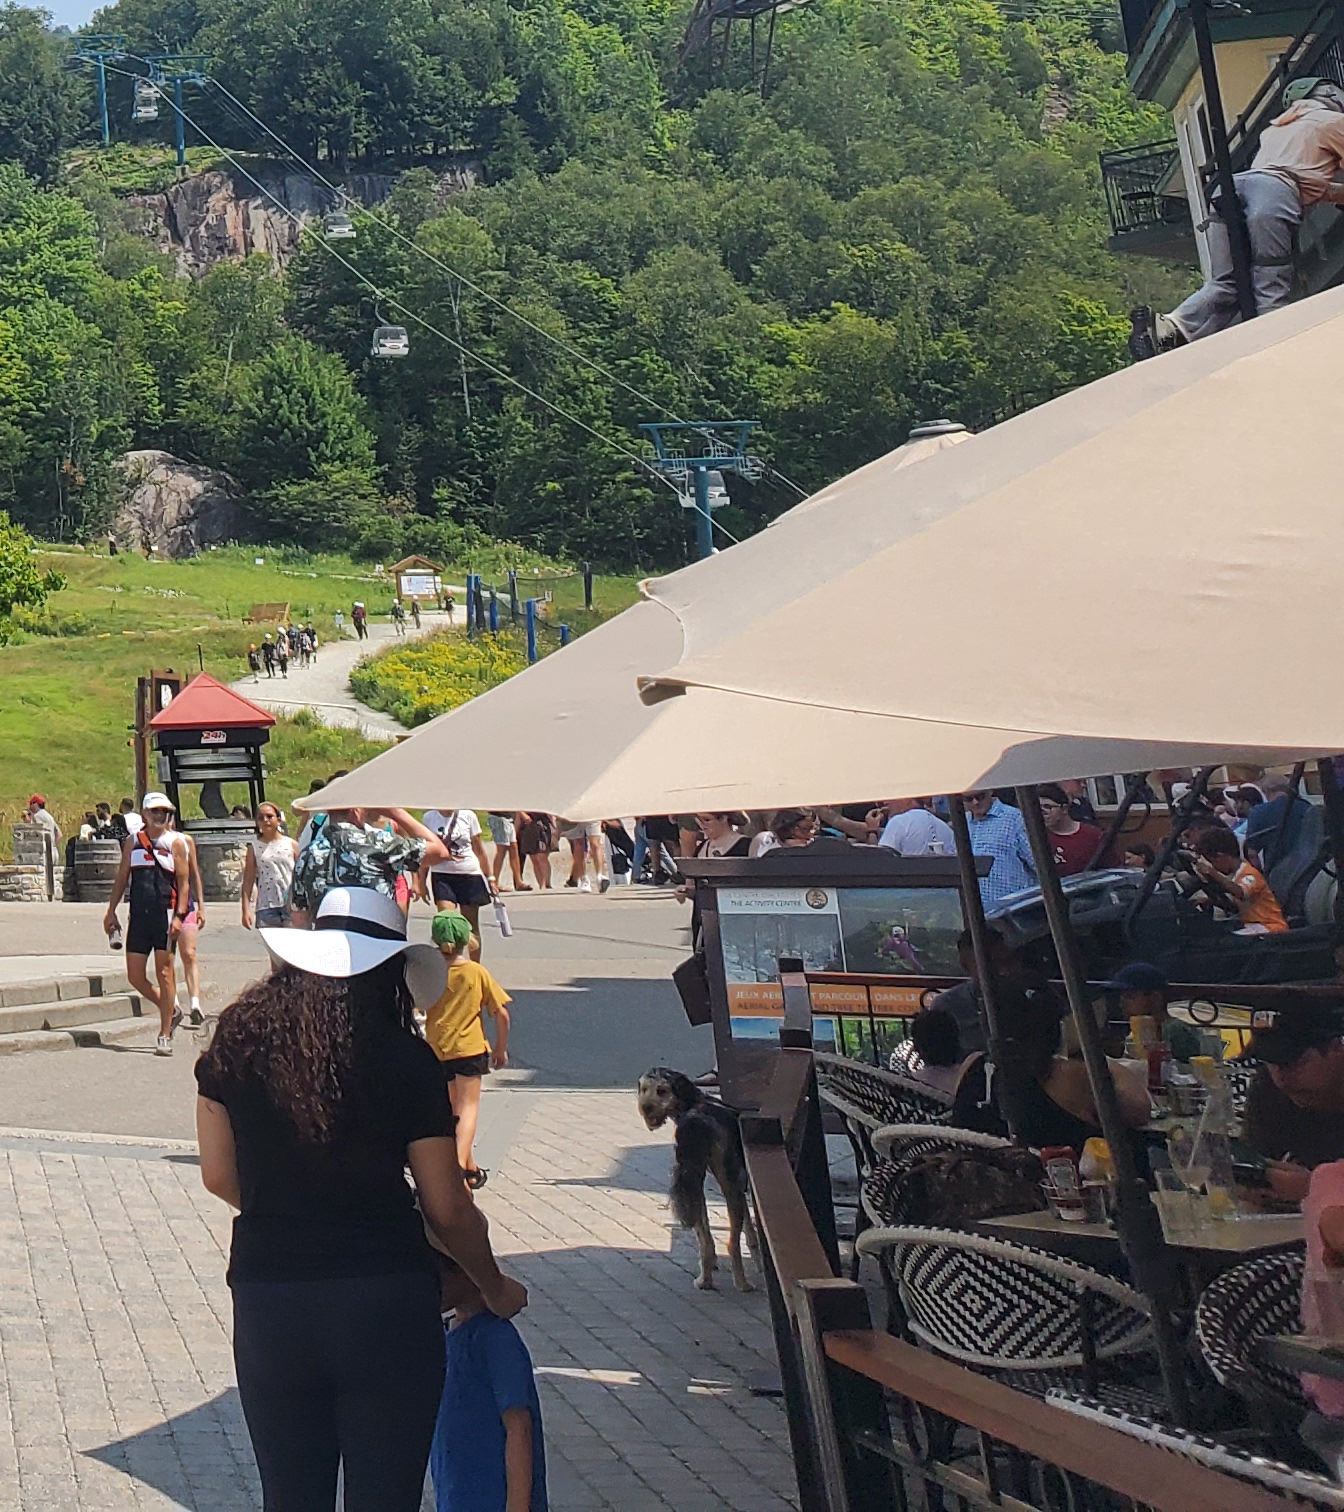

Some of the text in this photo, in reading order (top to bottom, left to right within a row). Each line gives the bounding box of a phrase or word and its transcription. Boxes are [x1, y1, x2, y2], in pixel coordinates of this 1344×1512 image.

[203, 731, 226, 739] 24h
[745, 899, 774, 908] ACTIVITY
[775, 899, 802, 908] CENTRE
[736, 991, 759, 1000] JEUX
[818, 991, 867, 1001] PARCOUR
[874, 993, 903, 1002] DANS
